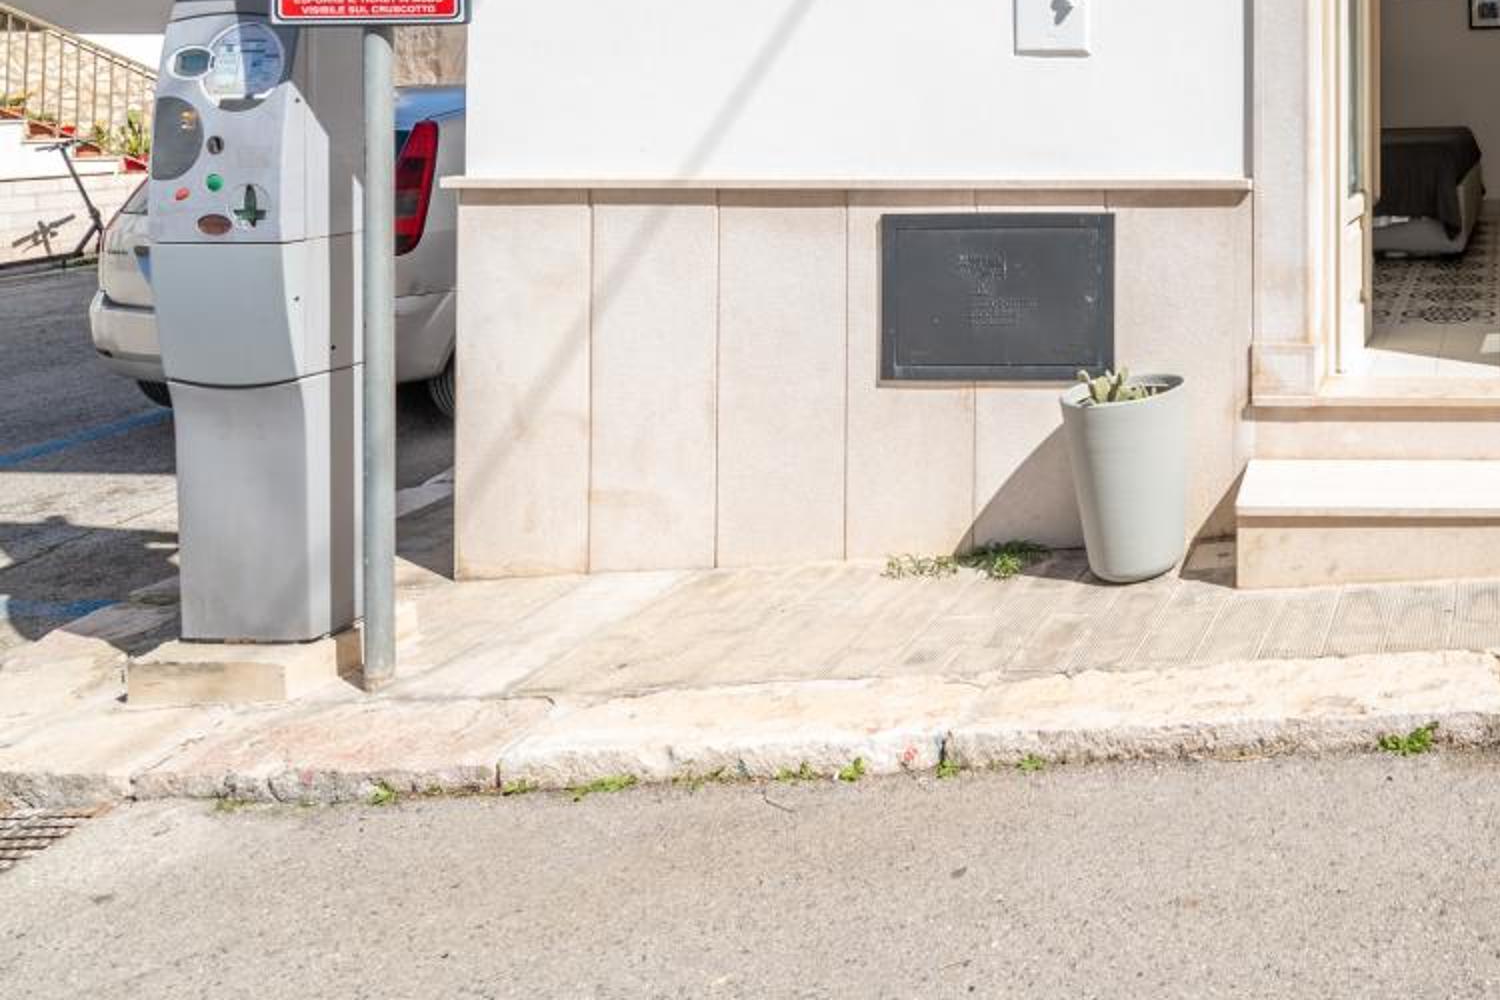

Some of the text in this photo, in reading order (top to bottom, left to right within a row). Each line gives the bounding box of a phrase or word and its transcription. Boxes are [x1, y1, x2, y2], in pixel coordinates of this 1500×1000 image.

[302, 5, 437, 14] VISIBILE SUL CRUSCOTTO
